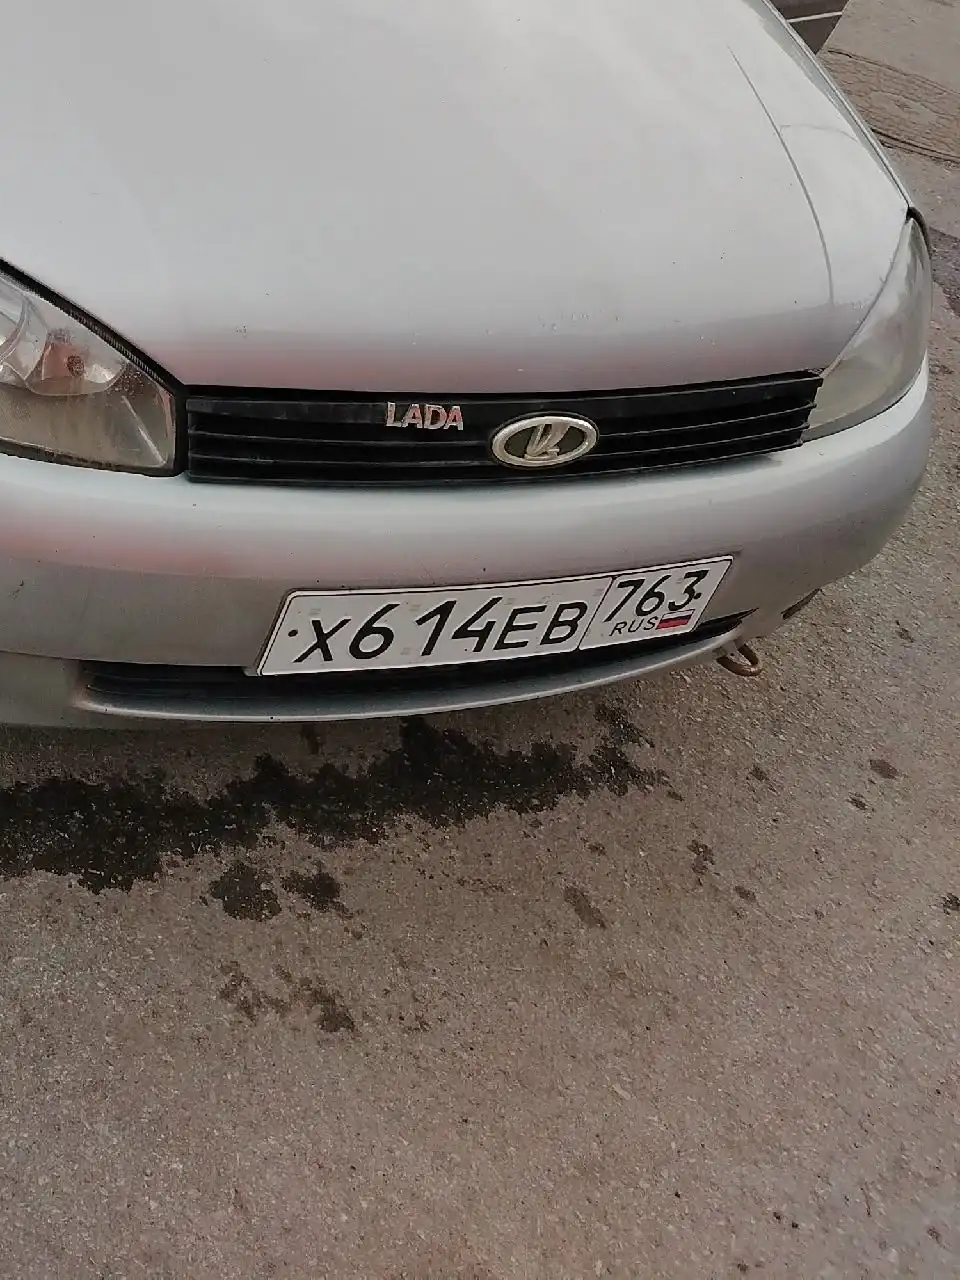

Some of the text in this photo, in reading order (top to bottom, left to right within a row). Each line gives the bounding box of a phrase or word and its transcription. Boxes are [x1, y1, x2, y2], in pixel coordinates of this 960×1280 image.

[385, 401, 464, 431] LADA
[603, 569, 708, 622] 763
[609, 616, 659, 637] RUS
